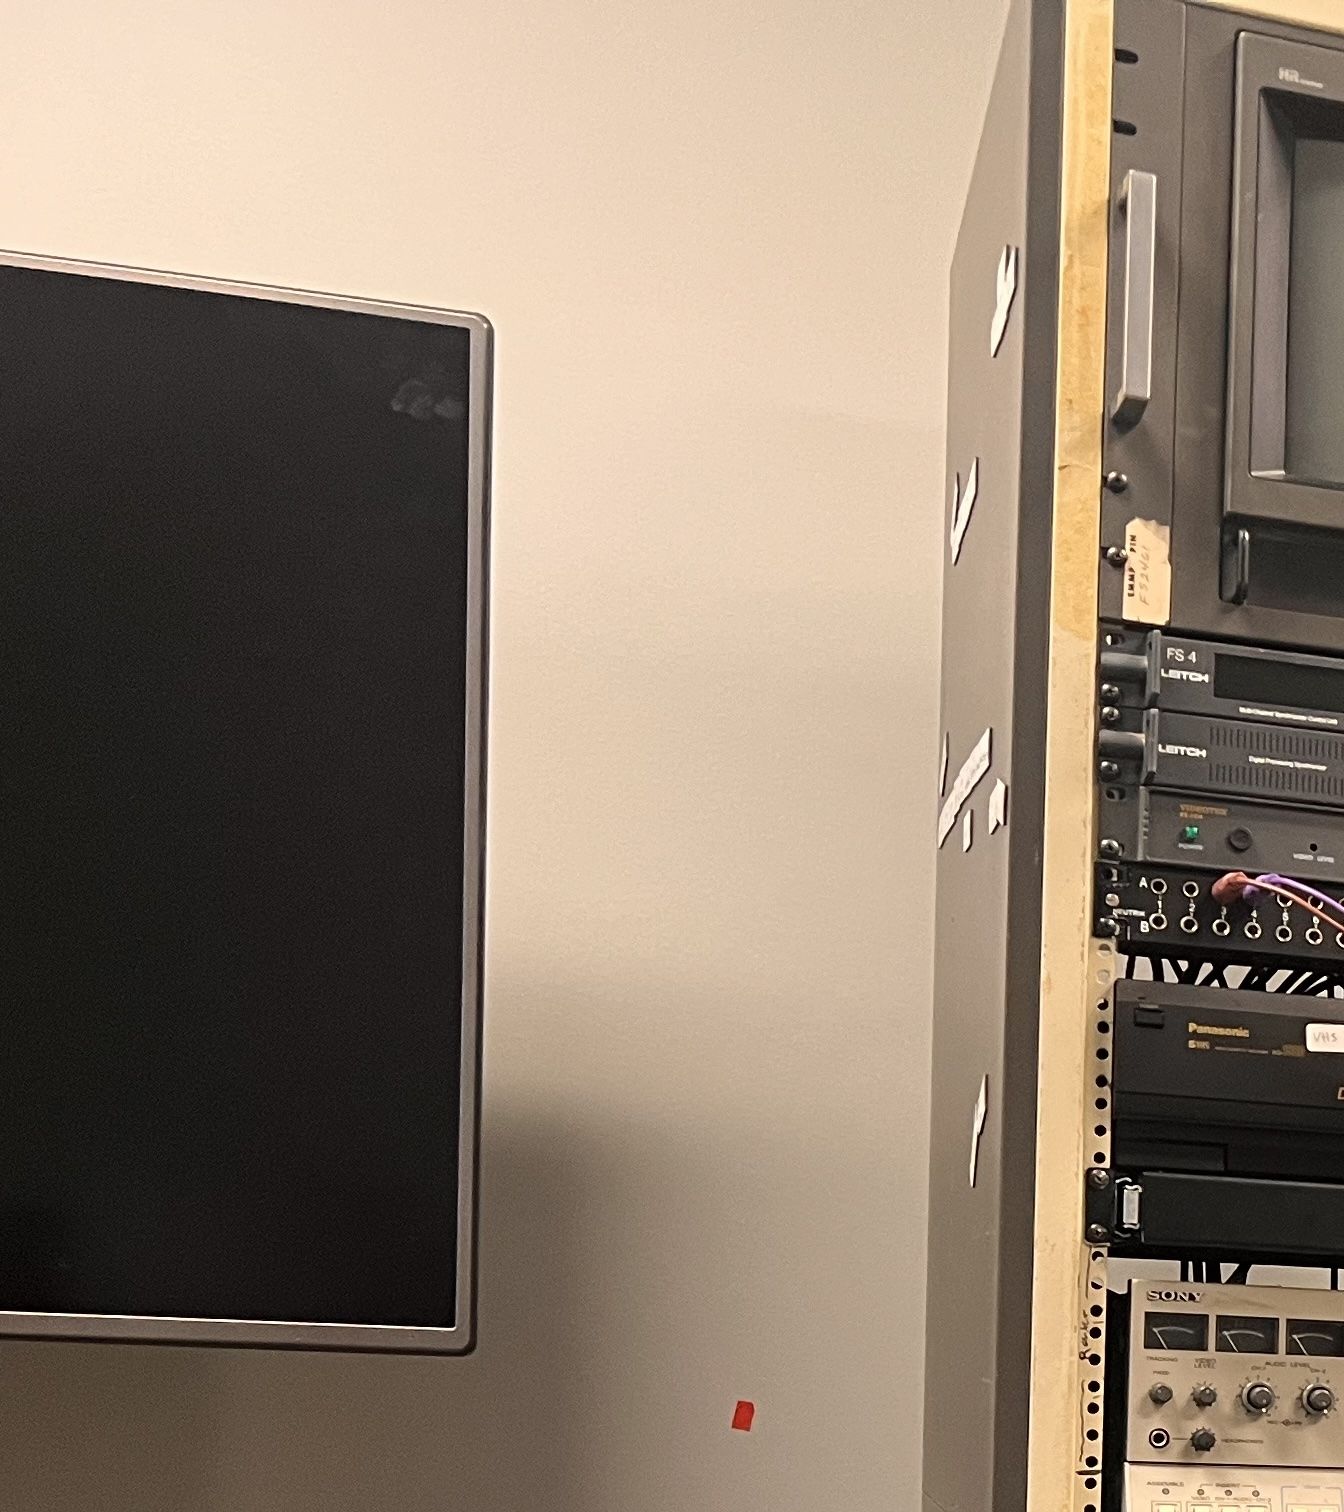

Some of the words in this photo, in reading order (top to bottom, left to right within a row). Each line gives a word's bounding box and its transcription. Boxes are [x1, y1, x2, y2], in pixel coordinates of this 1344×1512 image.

[1167, 647, 1185, 661] FS
[1188, 651, 1196, 663] 4
[1161, 668, 1209, 683] LEITCH
[1159, 744, 1207, 758] LEITCH
[1139, 877, 1148, 888] A
[1189, 903, 1196, 913] 2
[1221, 906, 1227, 917] 3
[1251, 907, 1258, 918] 4
[1140, 920, 1150, 932] B
[1188, 1022, 1250, 1038] Panasonic
[1147, 1290, 1205, 1303] SONY
